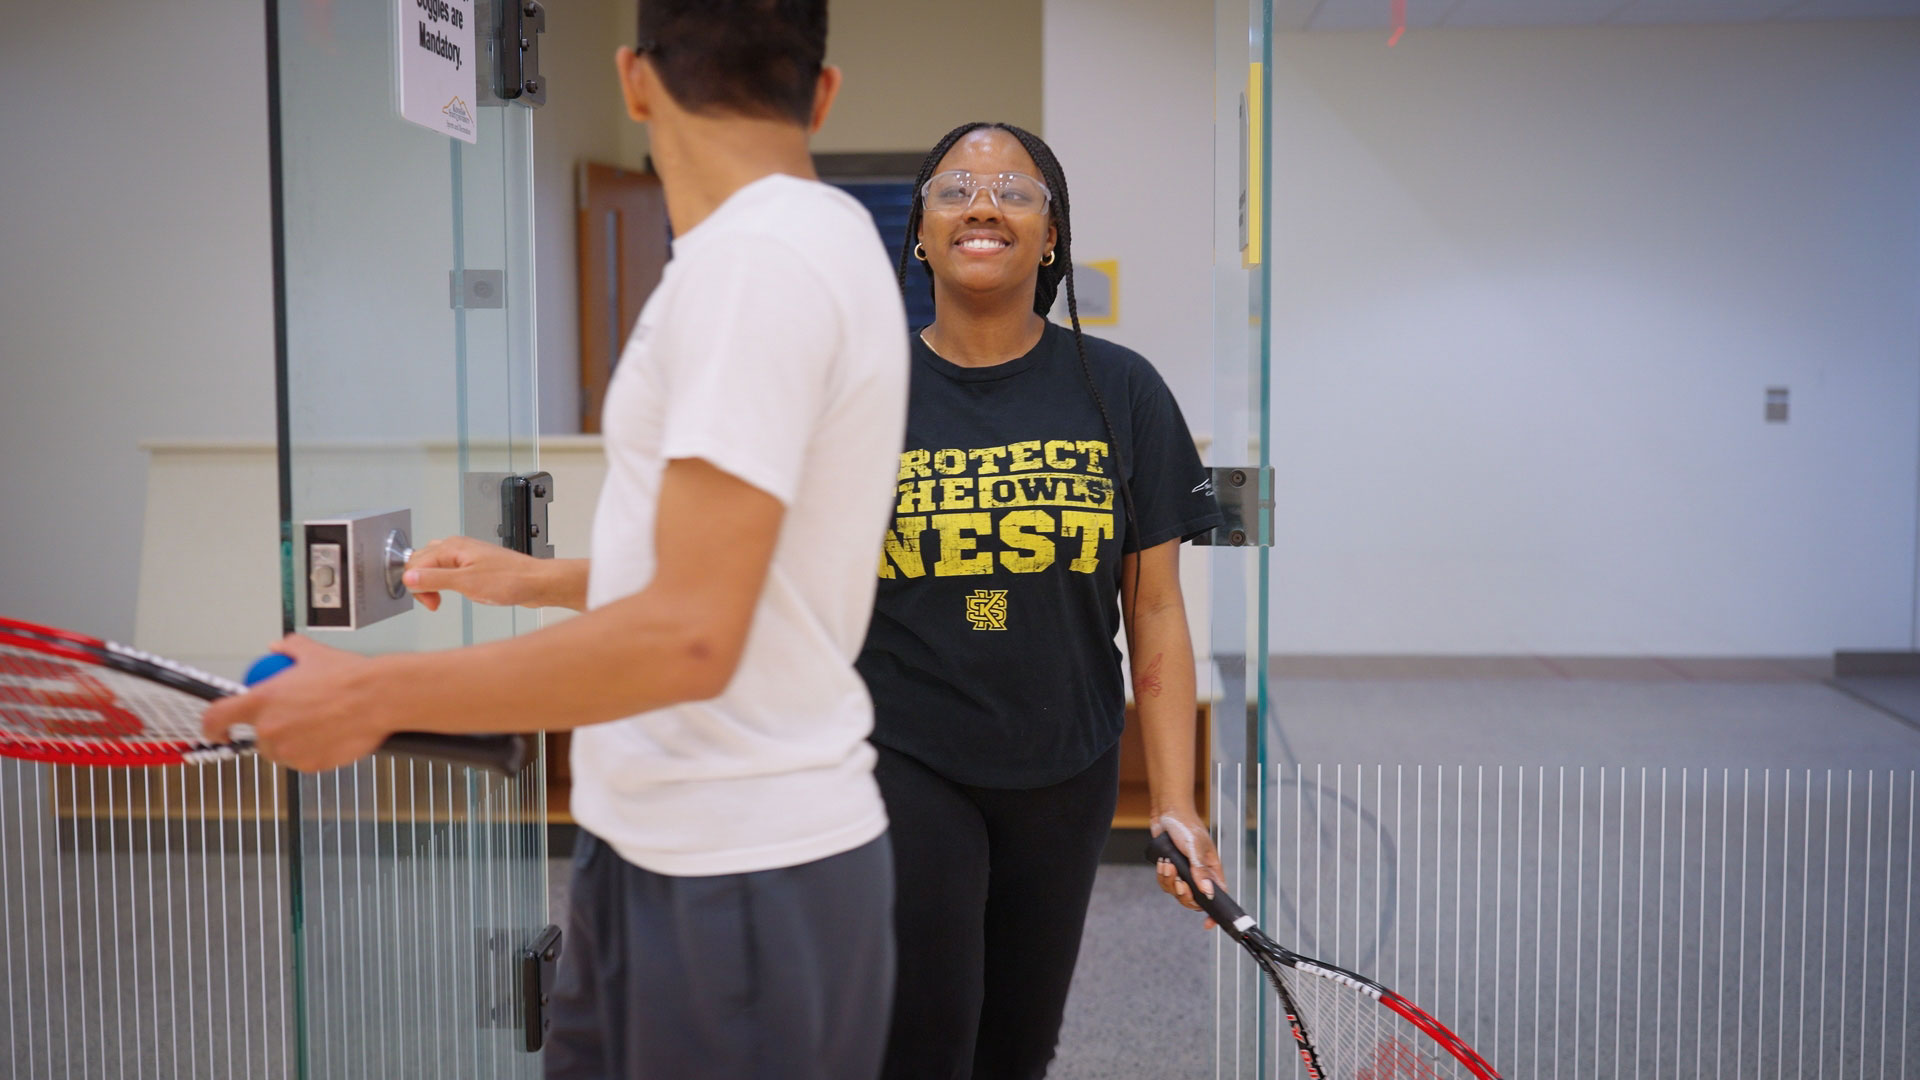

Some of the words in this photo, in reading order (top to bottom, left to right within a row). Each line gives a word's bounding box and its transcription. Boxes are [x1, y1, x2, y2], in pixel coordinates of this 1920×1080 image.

[416, 0, 449, 22] oggles
[451, 6, 463, 29] are
[418, 20, 462, 70] Mandatory.
[897, 440, 1109, 480] ROTECT
[893, 477, 975, 513] HE
[992, 477, 1108, 504] OWLS
[877, 510, 1114, 579] NEST
